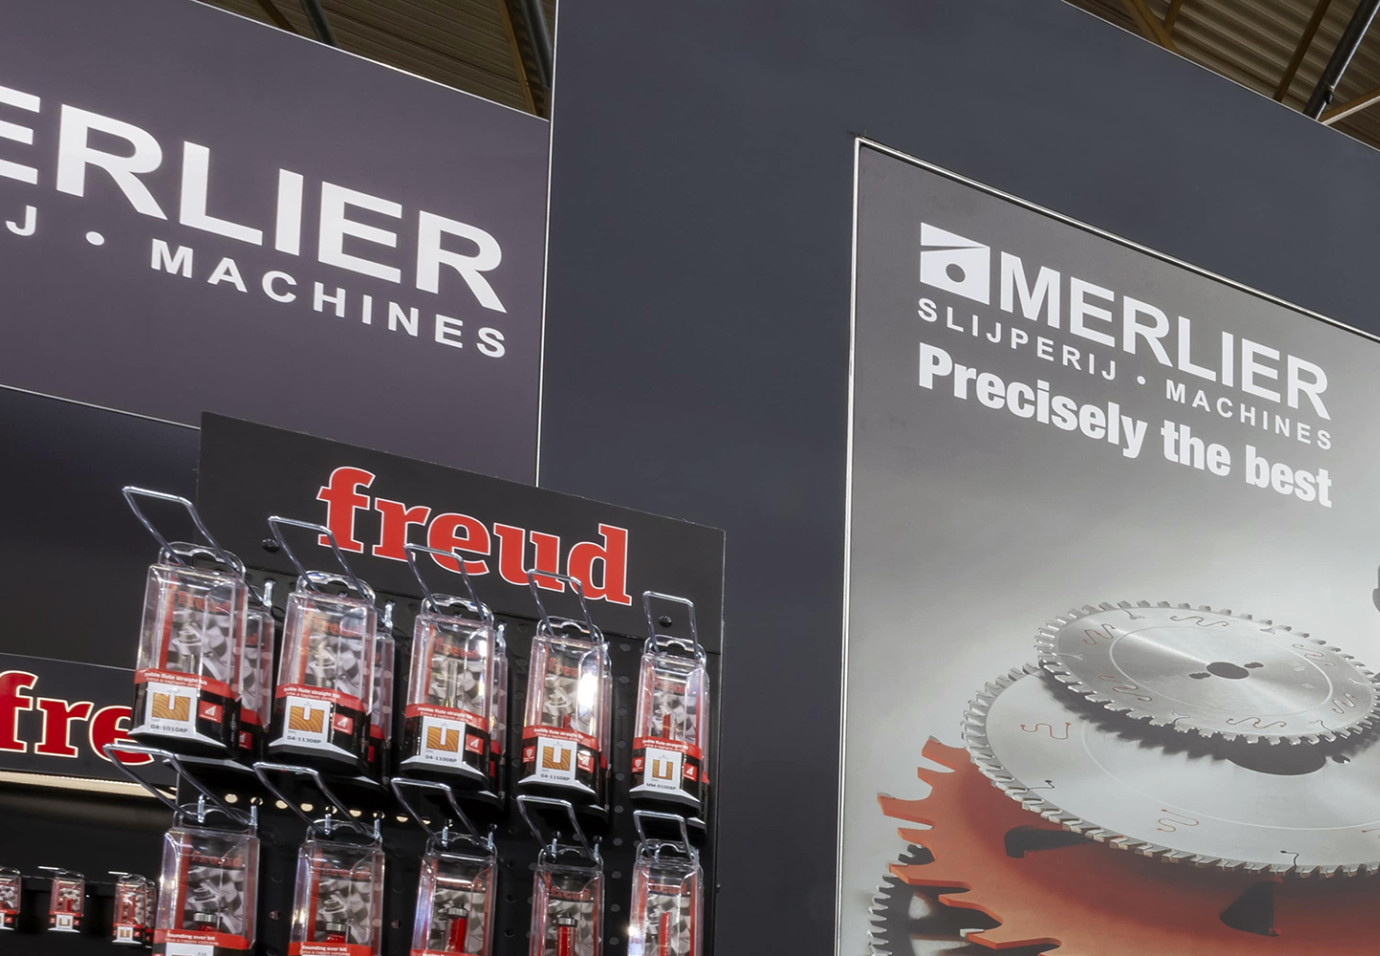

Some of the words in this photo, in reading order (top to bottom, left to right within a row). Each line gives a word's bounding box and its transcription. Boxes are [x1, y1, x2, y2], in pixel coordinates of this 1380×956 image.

[151, 239, 505, 358] MACHINES
[918, 298, 1116, 381] SLIJPERIJ
[1166, 378, 1332, 450] MACHINES
[1000, 251, 1331, 420] MERLIER
[919, 342, 1147, 459] Precisely
[1161, 420, 1231, 476] the
[1246, 445, 1332, 508] best
[317, 466, 632, 605] freud
